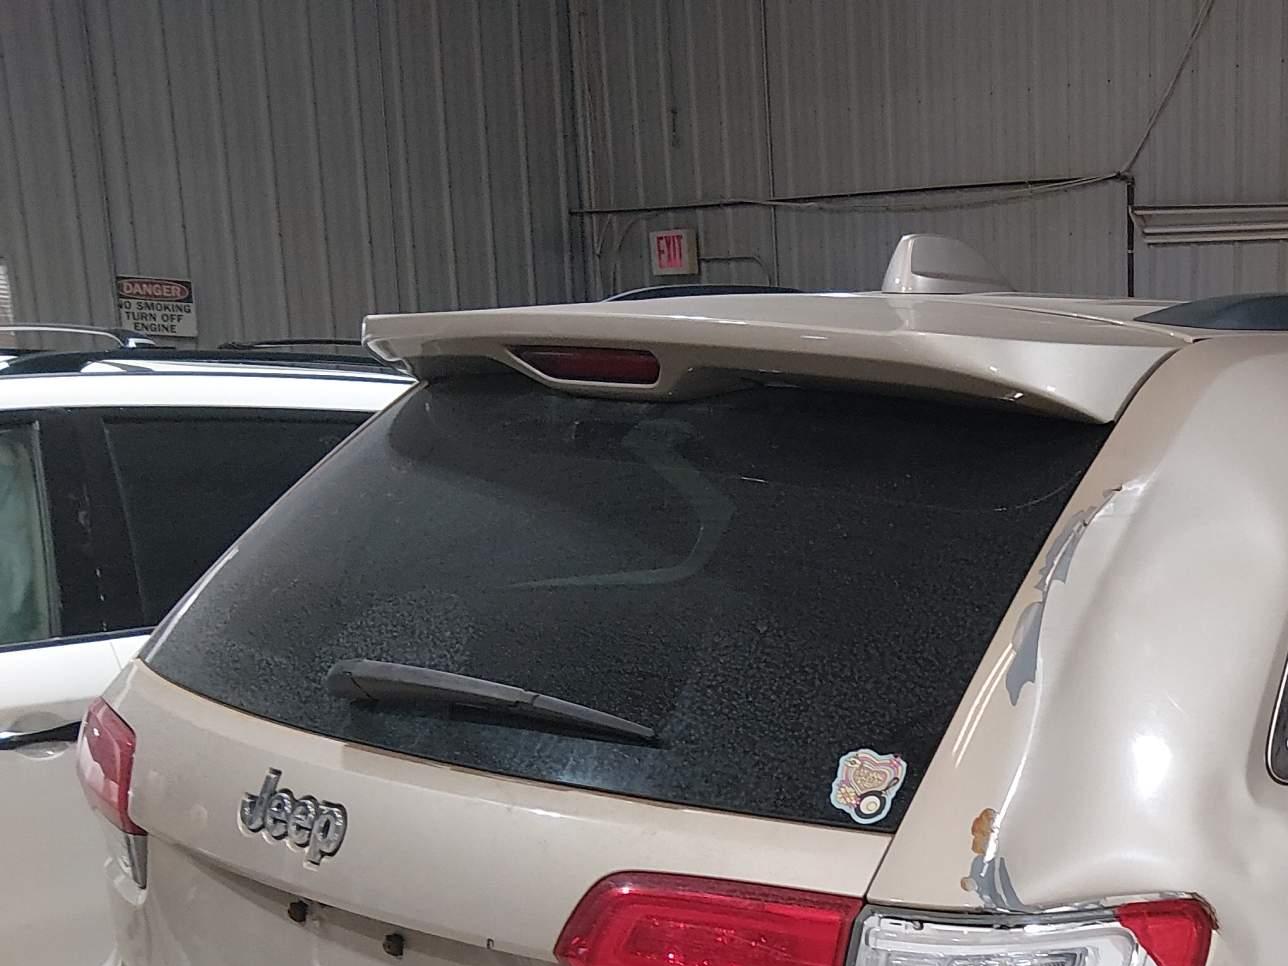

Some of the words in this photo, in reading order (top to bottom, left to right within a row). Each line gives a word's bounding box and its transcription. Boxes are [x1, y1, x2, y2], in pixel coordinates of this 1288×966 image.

[123, 282, 181, 297] DANGER
[136, 301, 192, 313] SMOKING
[125, 311, 157, 321] TURN
[161, 313, 184, 323] OFF
[134, 322, 177, 333] ENGINE
[240, 766, 348, 866] Jeep
